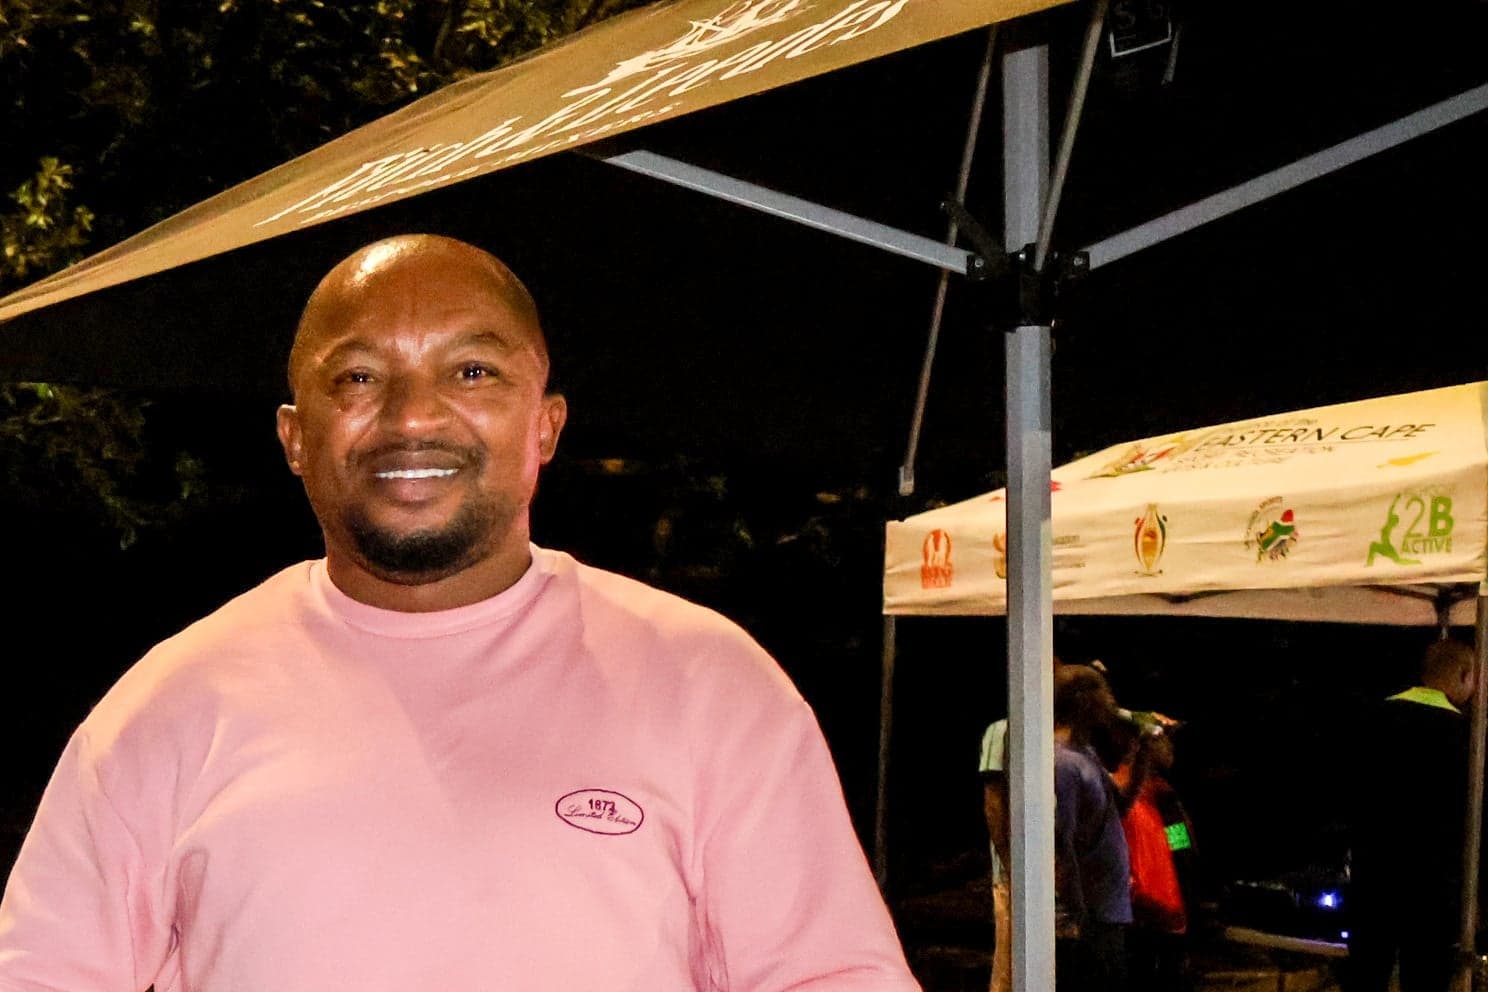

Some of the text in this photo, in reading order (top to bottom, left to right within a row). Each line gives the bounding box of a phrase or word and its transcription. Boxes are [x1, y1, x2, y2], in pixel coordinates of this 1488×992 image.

[1195, 426, 1339, 451] EASTERN
[1340, 422, 1436, 441] CAPE
[1402, 495, 1455, 538] 2B
[1401, 536, 1453, 554] ACTIVE
